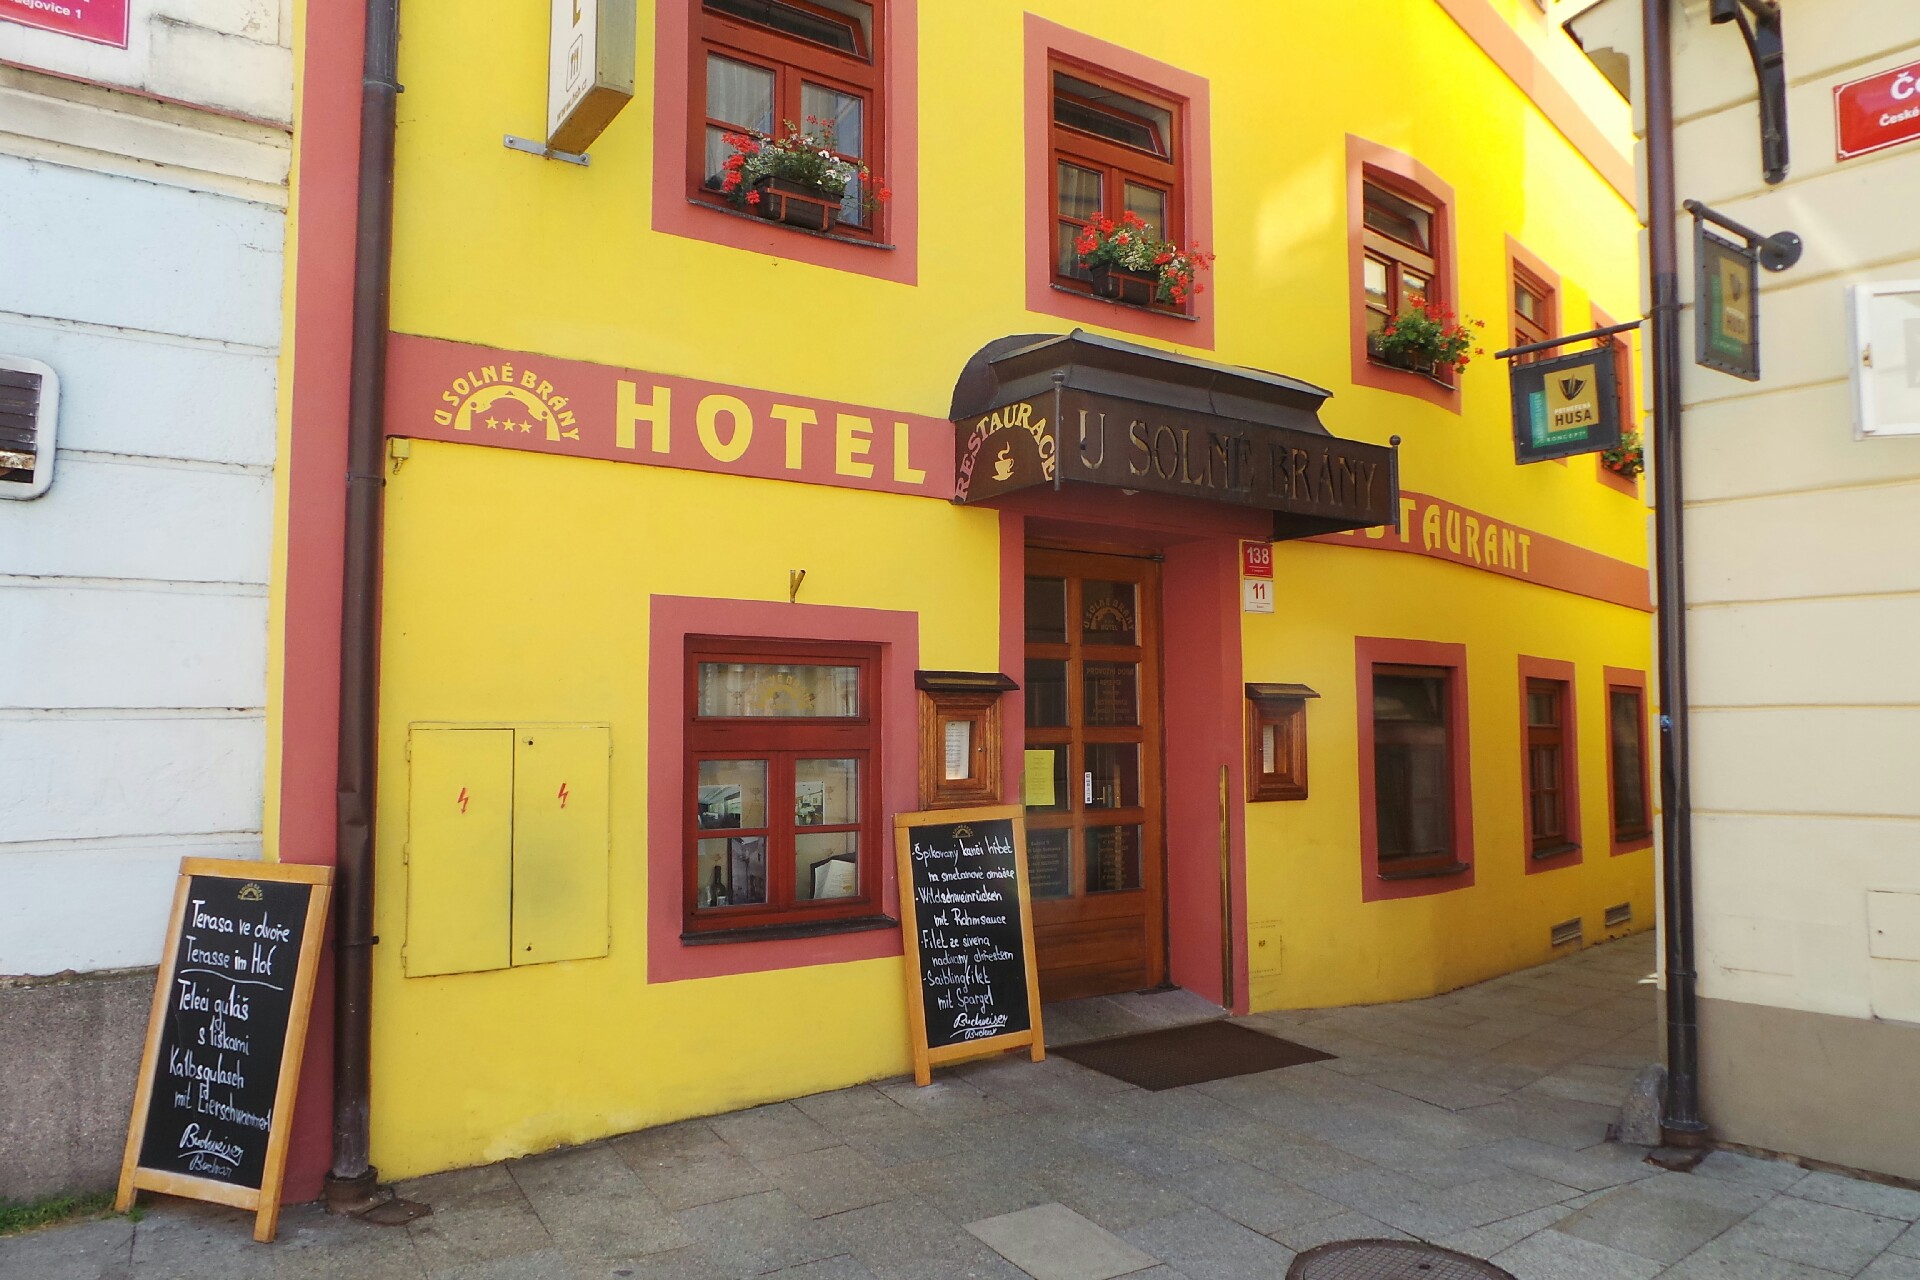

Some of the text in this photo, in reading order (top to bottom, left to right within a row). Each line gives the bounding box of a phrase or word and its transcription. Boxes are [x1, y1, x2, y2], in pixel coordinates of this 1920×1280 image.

[75, 9, 82, 19] 1
[434, 362, 580, 441] U SOLNÉ BRÁNY
[615, 379, 927, 484] HOTEL
[1555, 409, 1592, 427] HUSA
[955, 402, 1056, 502] RESTAURACE
[1079, 409, 1378, 511] U SOLNÉ BRÁNY
[1337, 498, 1531, 573] TAURANT
[1247, 546, 1269, 565] 138
[1253, 583, 1265, 600] 11
[192, 899, 291, 943] Terasa ve dvoře
[933, 907, 1007, 927] mit Rahmsauce
[185, 934, 277, 976] Terasse im Hof
[950, 937, 960, 948] ze
[937, 984, 994, 1014] mit Spargel
[174, 1080, 193, 1110] mit
